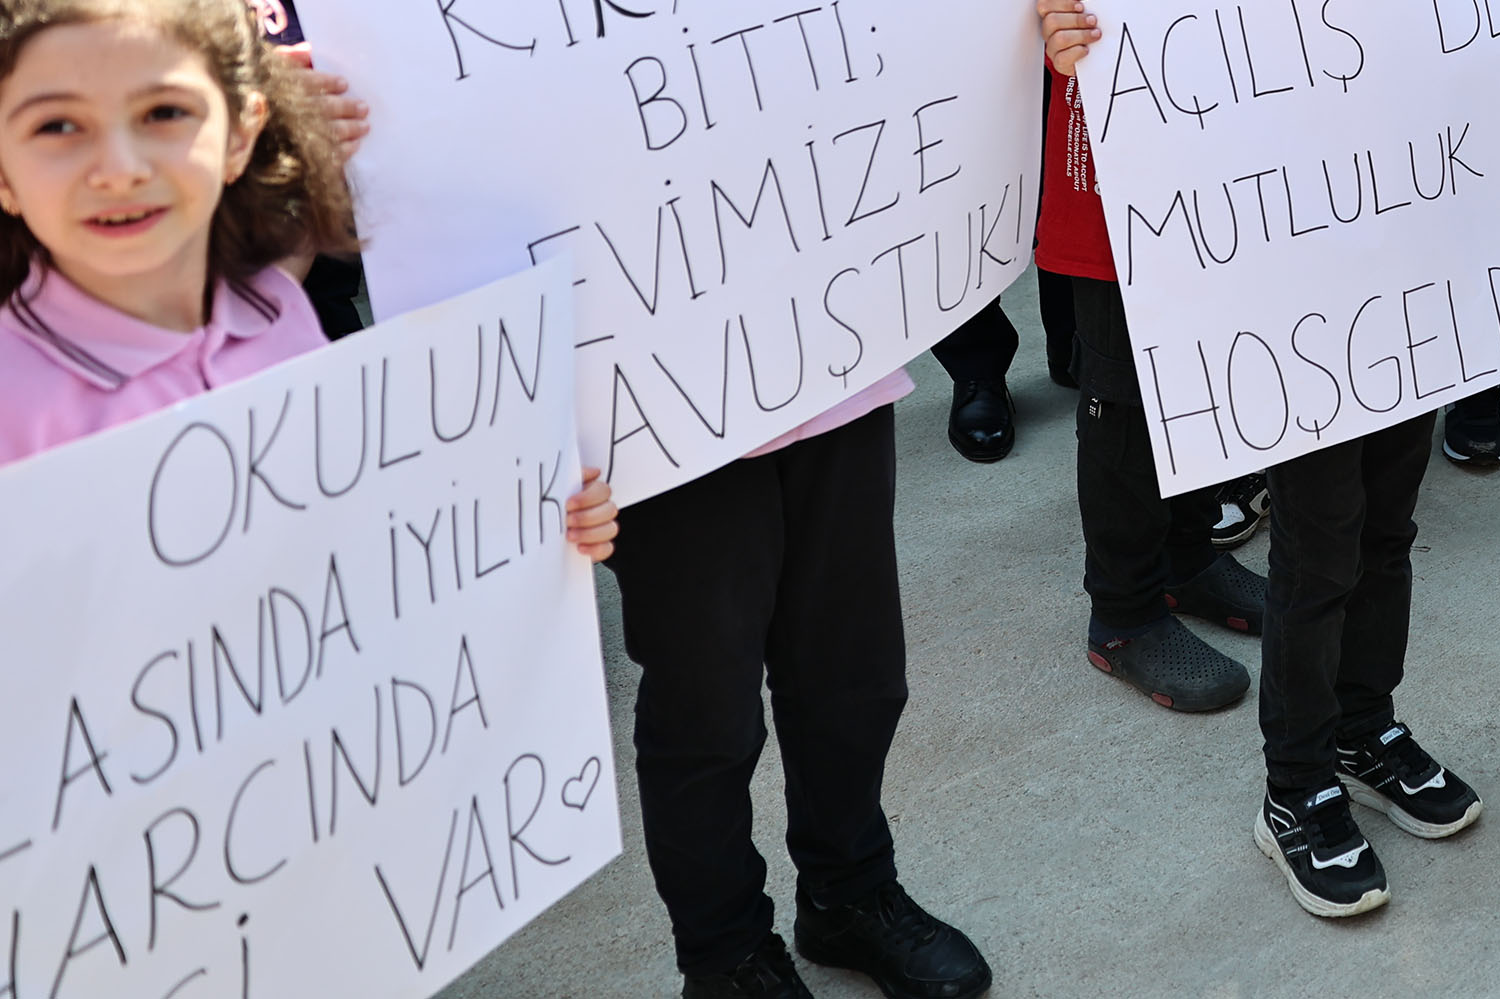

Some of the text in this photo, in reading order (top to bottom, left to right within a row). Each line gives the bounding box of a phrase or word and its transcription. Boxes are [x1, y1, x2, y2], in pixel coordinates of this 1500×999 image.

[606, 172, 1026, 485] AVUŞTUK!
[1126, 122, 1486, 287] MUTLULUK
[148, 293, 544, 568] OKULUN
[0, 449, 565, 862] ASINDA İYİLİK
[374, 752, 572, 972] VAR
